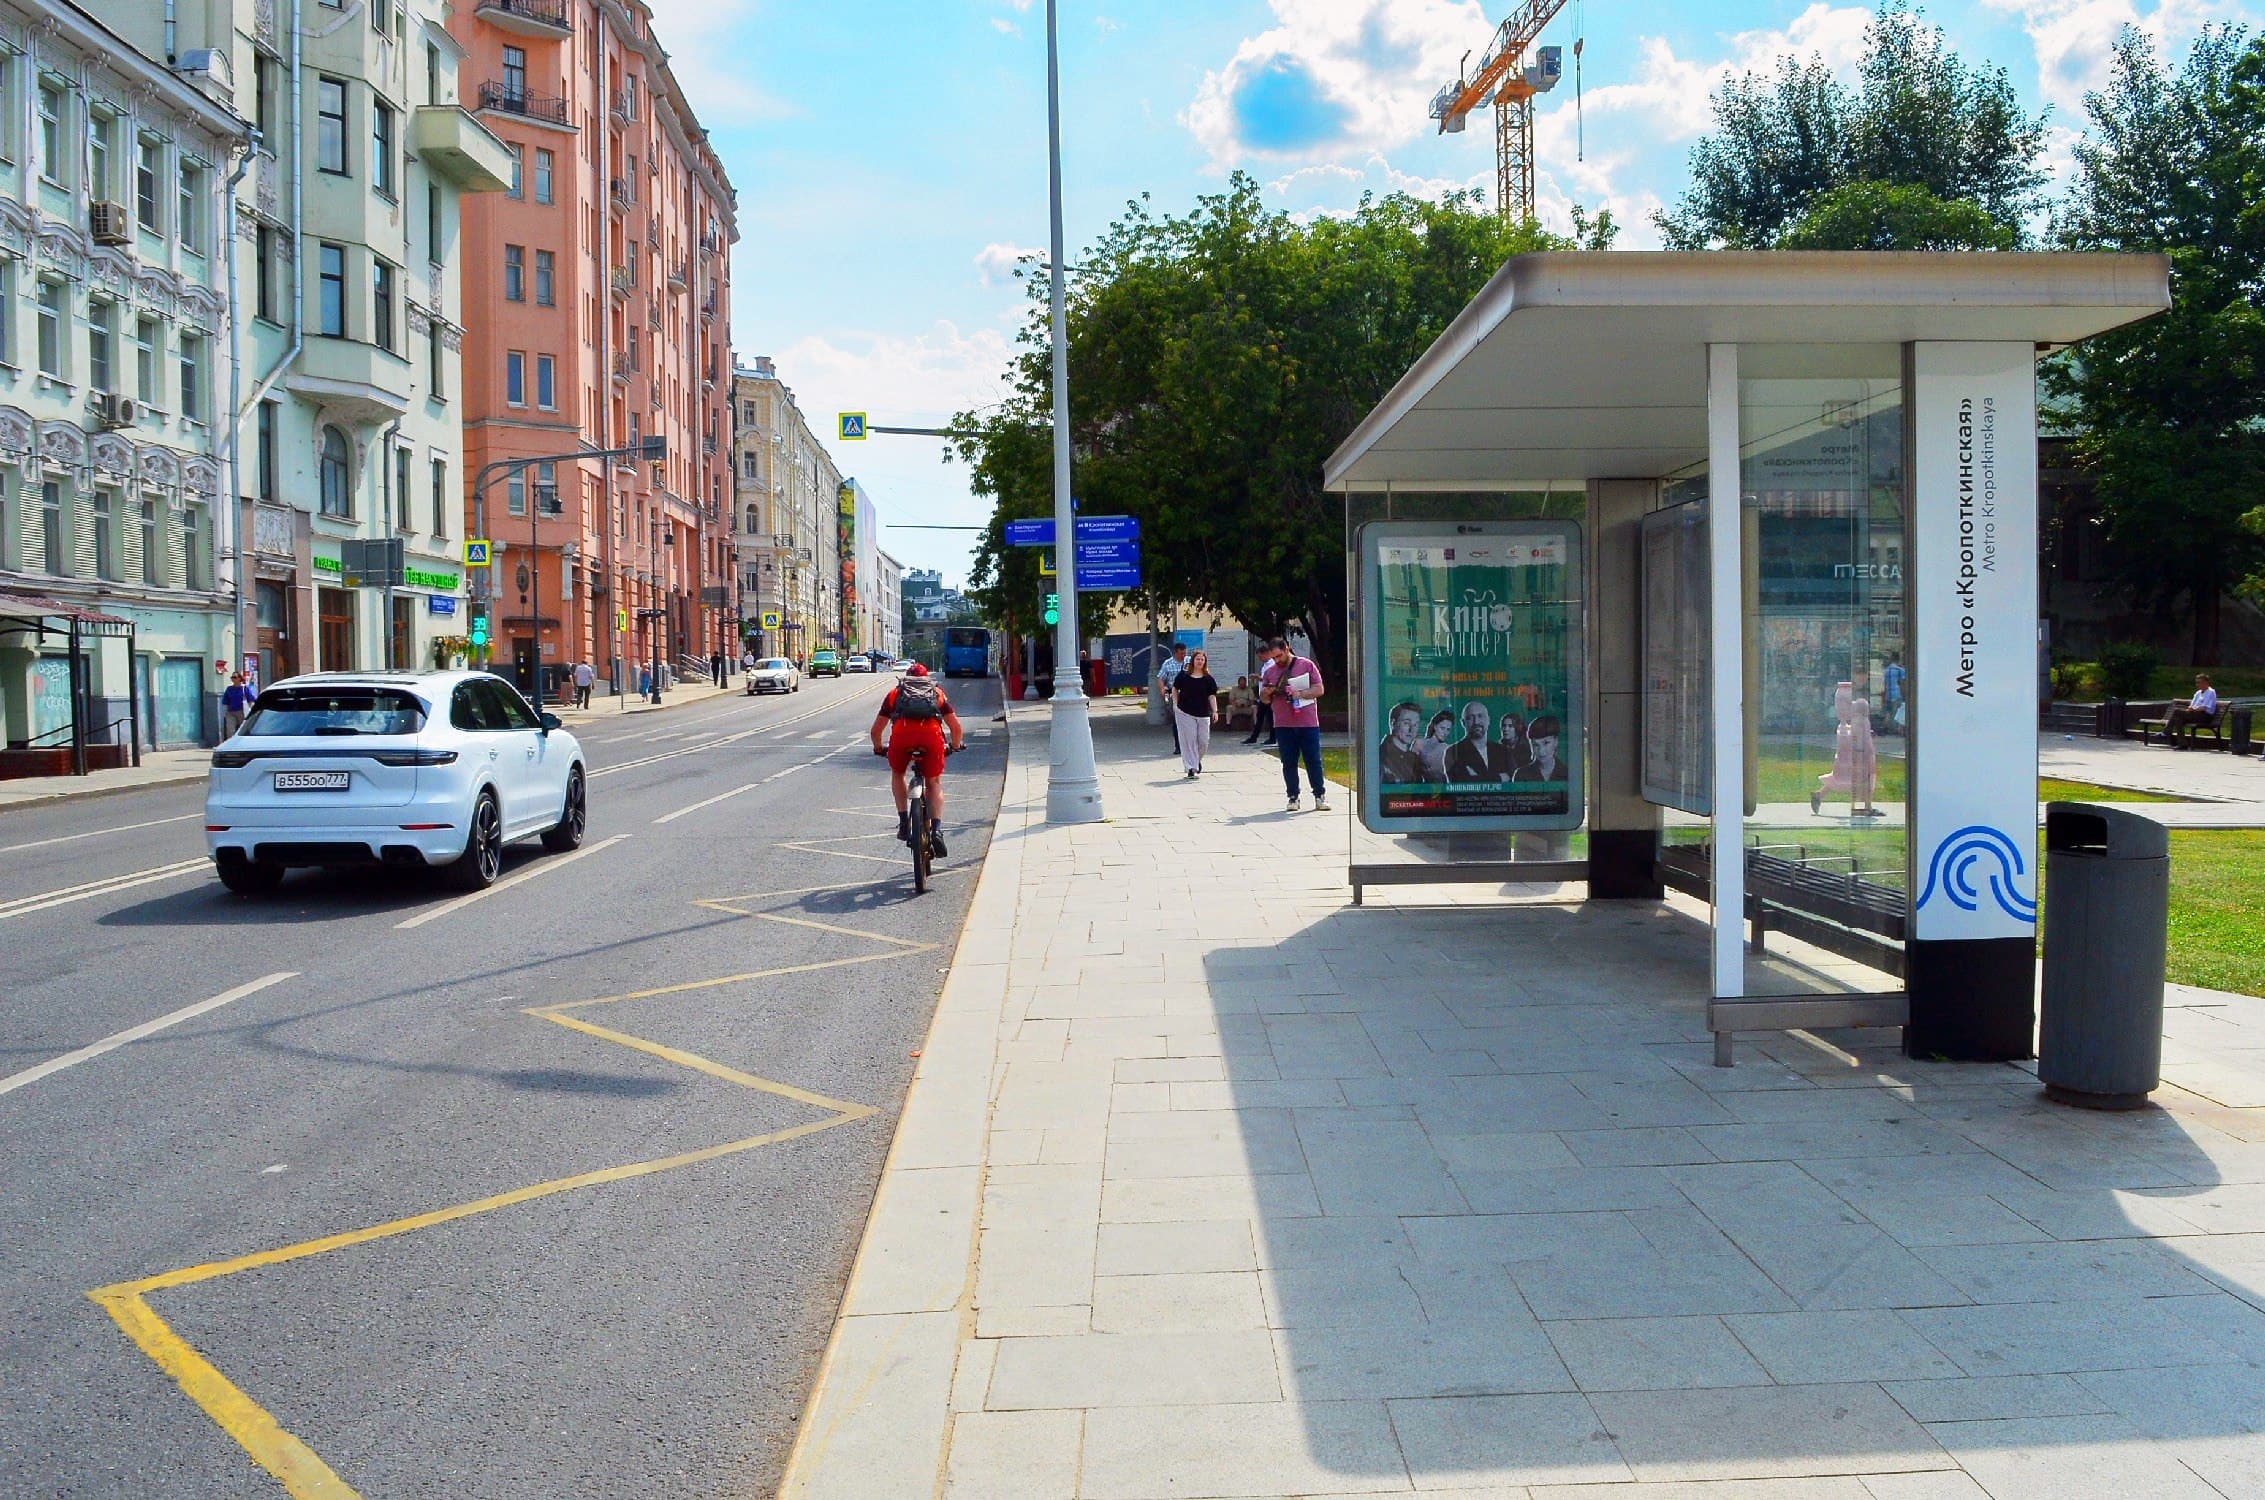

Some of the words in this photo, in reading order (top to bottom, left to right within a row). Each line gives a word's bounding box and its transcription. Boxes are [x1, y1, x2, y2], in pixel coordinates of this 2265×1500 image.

[1981, 397, 1997, 518] Kropotkinskaya
[1956, 398, 1978, 609] «Кропоткинская»
[1982, 522, 1996, 572] Metro
[1434, 604, 1513, 633] КИНО
[1434, 632, 1512, 656] КОНЦЕРТ
[1956, 615, 1978, 698] Метро
[327, 773, 345, 783] 777
